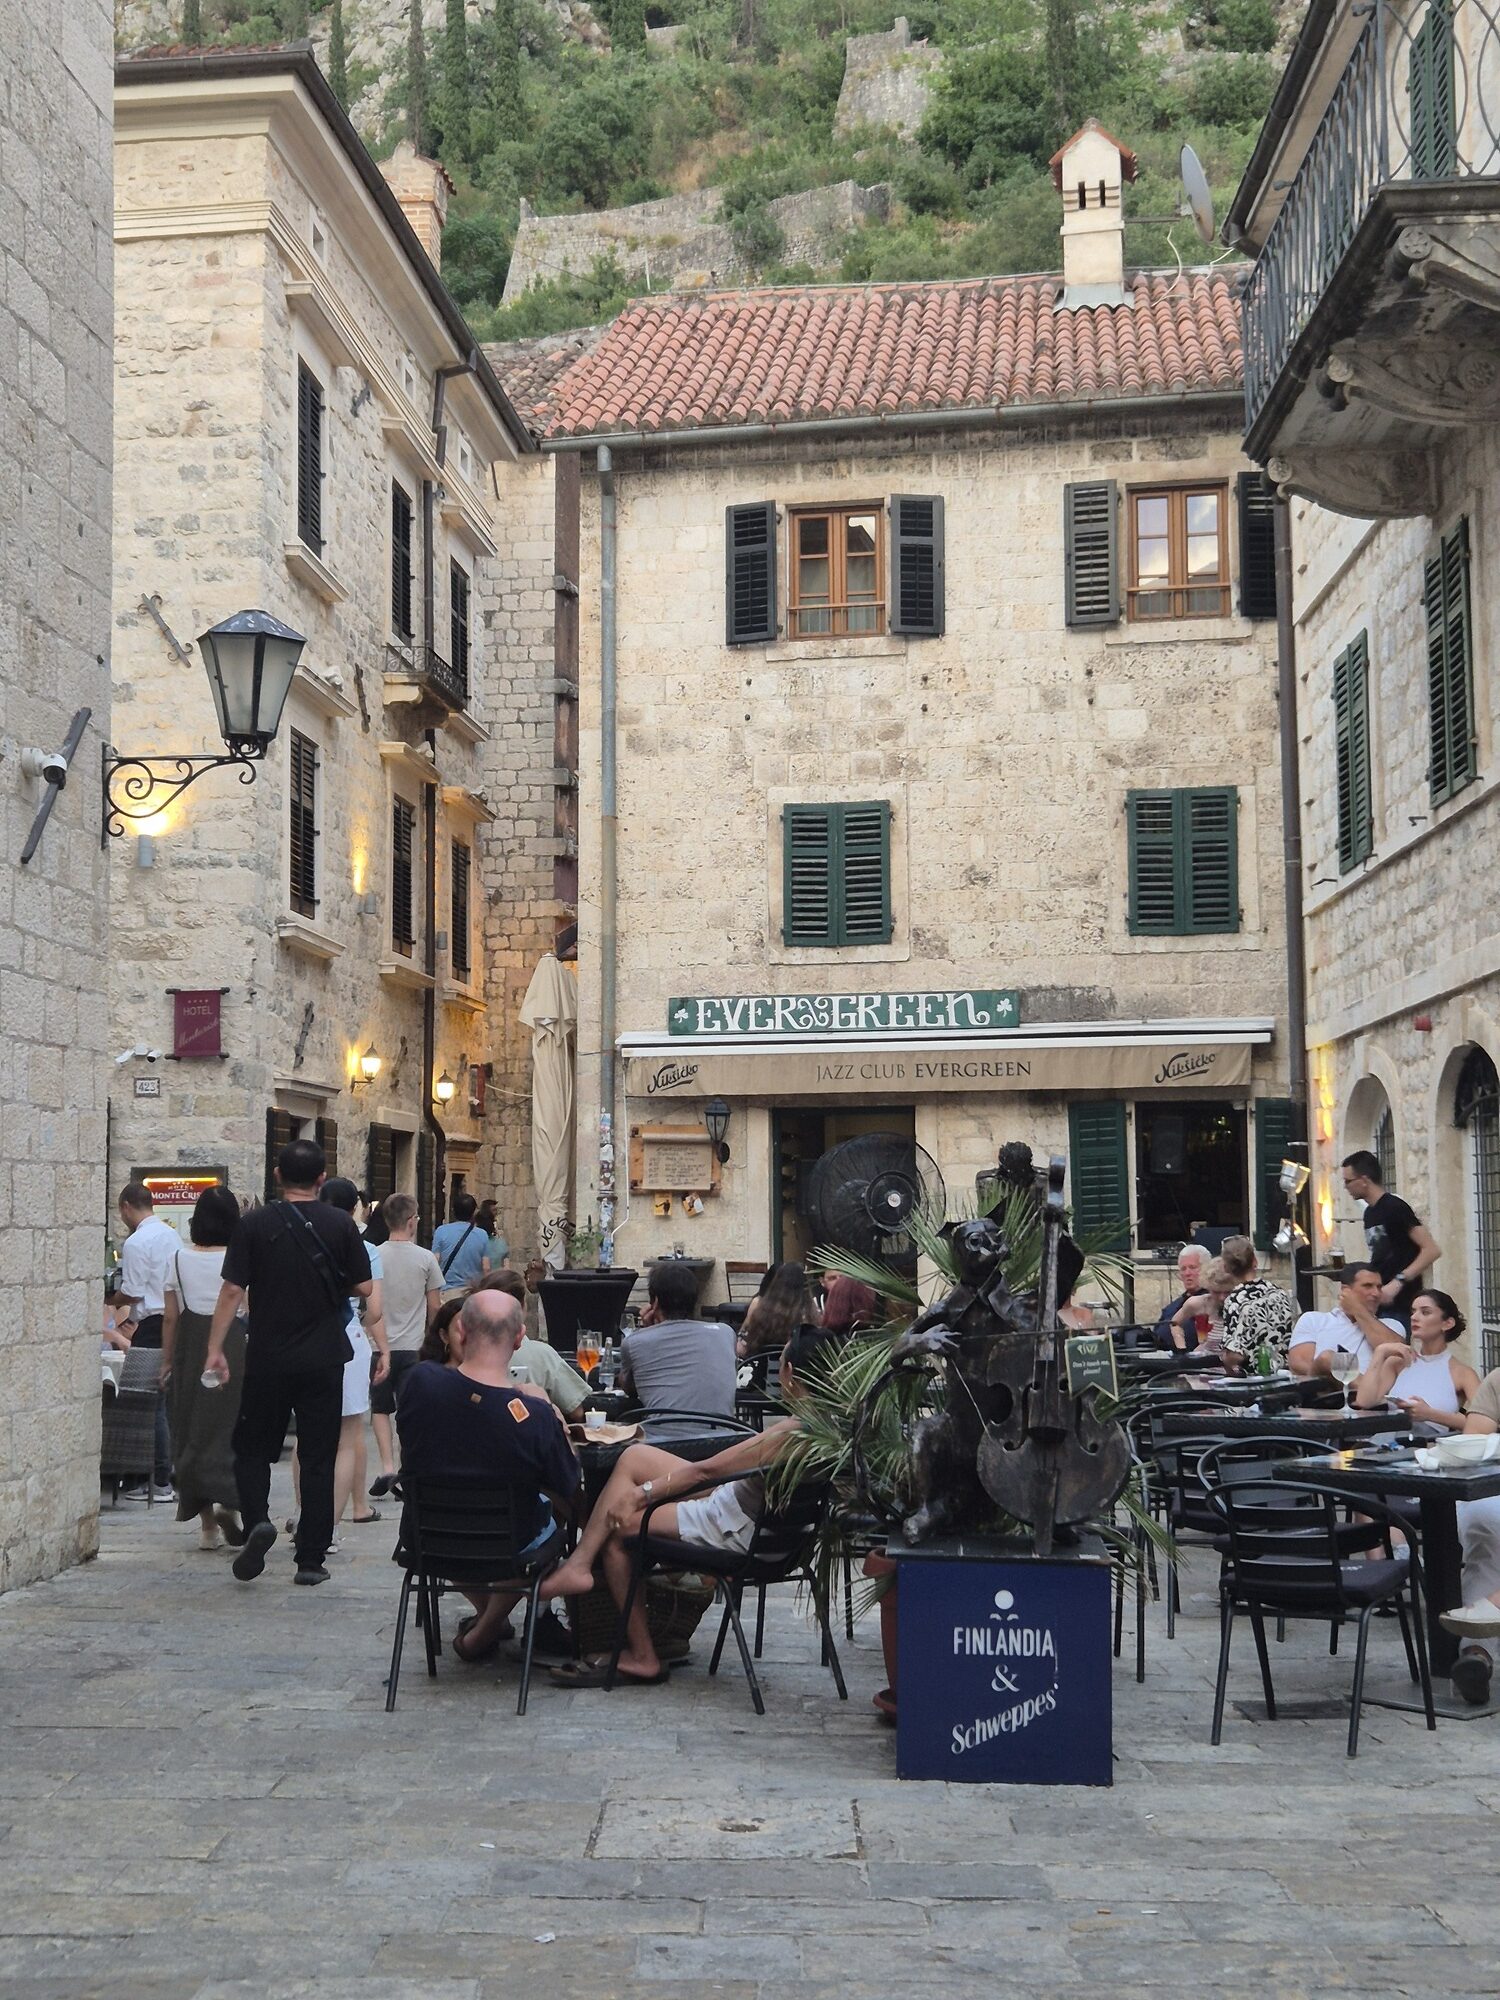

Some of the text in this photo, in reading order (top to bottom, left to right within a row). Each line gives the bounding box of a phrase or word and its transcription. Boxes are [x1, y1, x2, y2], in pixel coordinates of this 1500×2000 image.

[183, 1005, 213, 1016] HOTEL
[647, 1063, 699, 1094] Nikšićko
[816, 1061, 1032, 1083] JAZZ CLUB EVERGREEN
[1154, 1052, 1217, 1084] Nikšićko
[138, 1082, 156, 1092] 423
[151, 1190, 202, 1200] MONTE CRIS
[953, 1626, 1055, 1657] FINLANDIA
[991, 1663, 1020, 1692] &
[951, 1689, 1057, 1754] Schweppes
